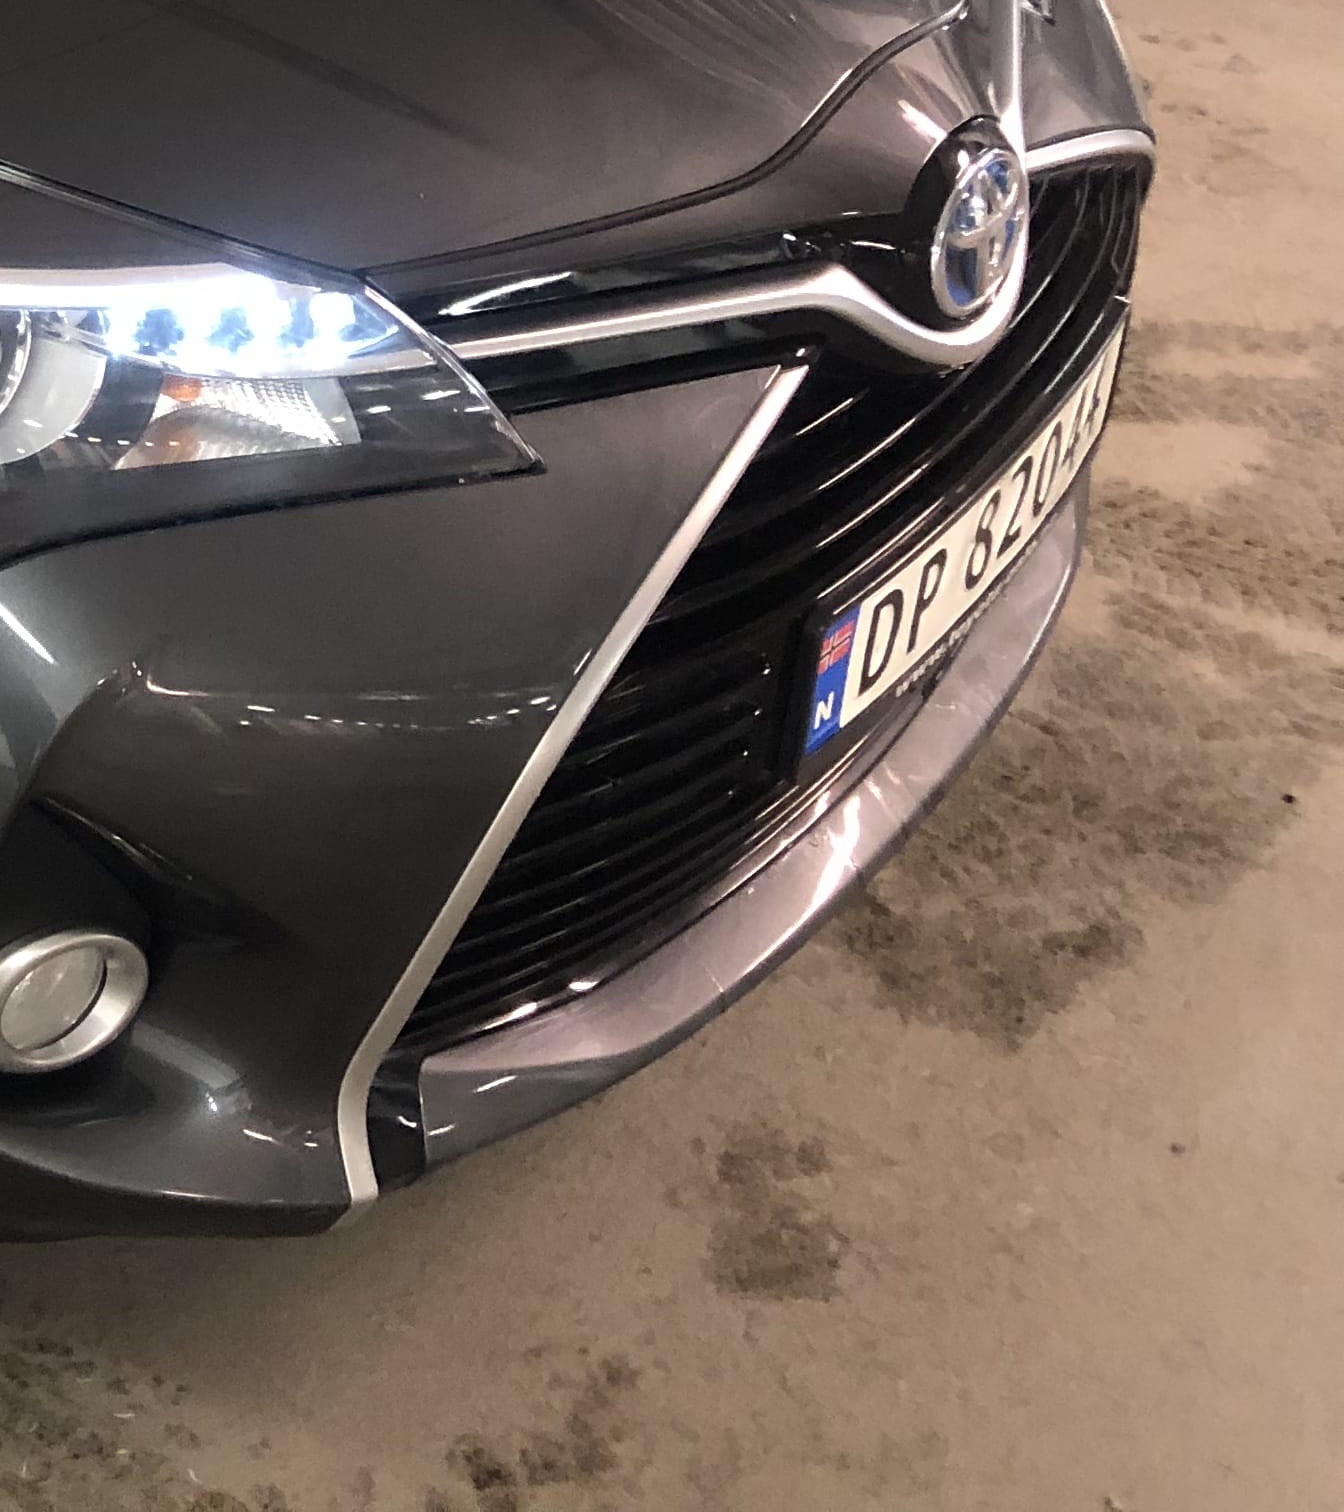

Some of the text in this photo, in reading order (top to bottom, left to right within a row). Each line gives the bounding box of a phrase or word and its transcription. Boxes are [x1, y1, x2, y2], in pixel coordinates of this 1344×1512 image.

[858, 548, 947, 697] DP
[965, 351, 1108, 590] 82044
[813, 691, 835, 731] N
